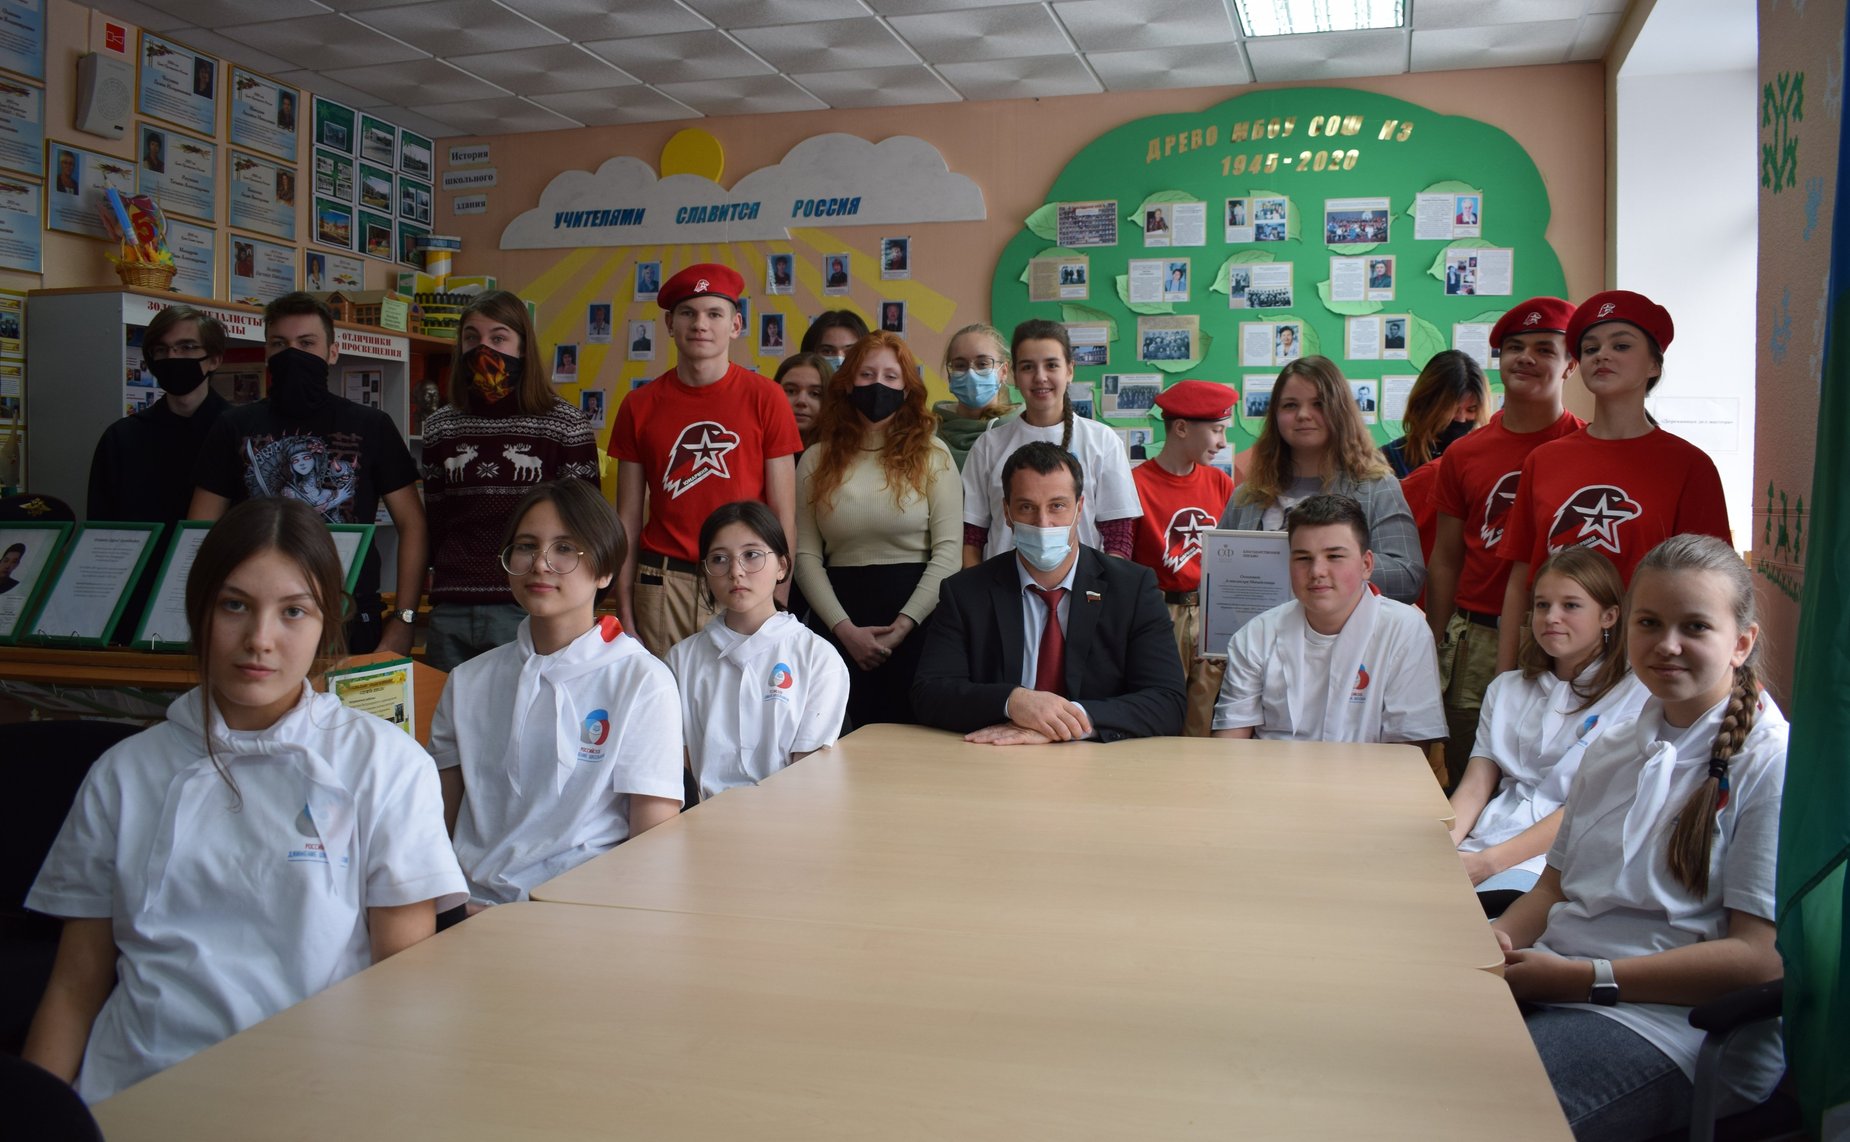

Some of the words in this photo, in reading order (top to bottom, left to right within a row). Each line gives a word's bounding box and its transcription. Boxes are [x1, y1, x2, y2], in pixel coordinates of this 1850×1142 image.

[1146, 125, 1218, 164] ДРЕВО
[1230, 116, 1297, 144] МБОУ
[1307, 115, 1364, 138] СОШ
[451, 151, 489, 161] История
[1220, 148, 1360, 177] 1945-2020
[445, 174, 494, 185] школьного
[456, 200, 486, 210] здания
[553, 207, 646, 229] УЧИТЕЛЯМИ
[675, 201, 761, 224] СЛАВИТСЯ
[791, 196, 862, 218] РОССИЯ
[341, 342, 402, 357] ПРОСВЕЩЕНИЯ
